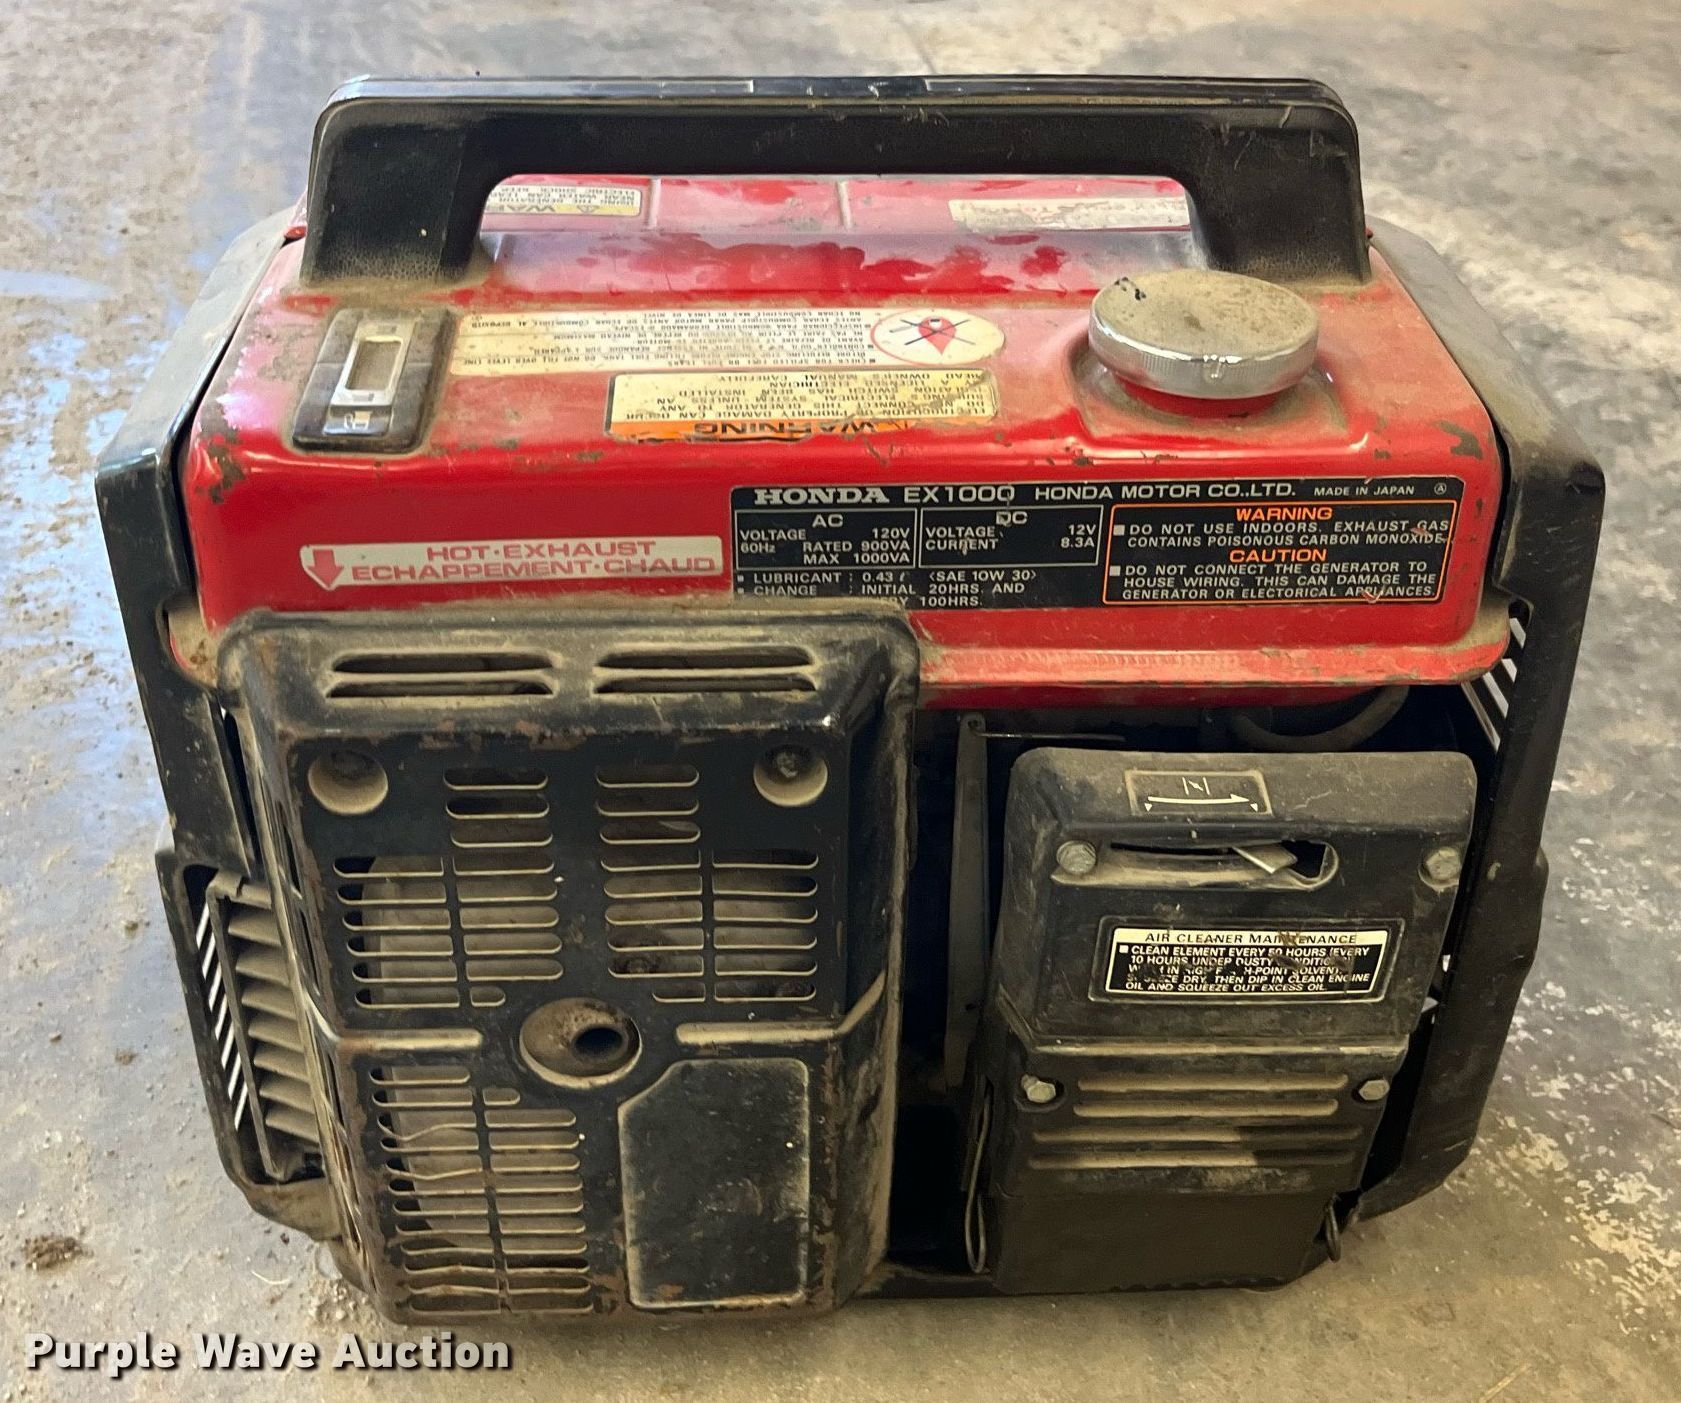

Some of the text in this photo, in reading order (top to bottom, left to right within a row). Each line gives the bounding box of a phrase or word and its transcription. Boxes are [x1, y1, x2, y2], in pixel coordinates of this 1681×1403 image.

[754, 488, 890, 505] HONDA
[904, 485, 1015, 502] EX1000
[1035, 486, 1113, 500] HONDA
[1122, 484, 1200, 500] MOTOR
[1314, 486, 1350, 496] MADE
[1355, 486, 1369, 496] IN
[1373, 485, 1415, 496] JAPAN
[812, 514, 843, 528] AC
[996, 511, 1028, 525] DC
[1236, 507, 1333, 522] WARNING
[740, 528, 910, 541] VOLTAGE 120V
[926, 525, 1096, 538] VOLTAGE 12V
[1130, 520, 1449, 535] DO NOT USE INDOORS. EXHAUST GAS
[740, 540, 910, 553] 60Hz RATED 900VA
[926, 537, 1095, 550] CURRENT 8.3A
[1127, 536, 1201, 547] CONTAINS
[1207, 534, 1293, 546] POISONOUS
[1299, 533, 1362, 546] CARBON
[803, 553, 910, 564] MAX 1000VA
[1229, 549, 1327, 563] CAUTION
[1125, 560, 1428, 576] DO NOT CONNECT THE GENERATOR TO
[754, 572, 841, 584] LUBRICANT
[862, 572, 893, 583] 0.43
[972, 570, 1005, 581] 10W
[1124, 572, 1437, 588] HOUSE WIRING. THIS CAN DAMAGE THE
[754, 585, 817, 596] CHANGE
[862, 585, 916, 595] INITIAL
[992, 582, 1025, 594] AND
[1122, 587, 1208, 600] GENERATOR
[1214, 586, 1235, 599] OR
[1241, 585, 1337, 599] ELECTORICAL
[1145, 933, 1170, 942] AIR
[1177, 934, 1243, 943] CLEANER
[1131, 945, 1170, 955] CLEAN
[1173, 946, 1226, 956] ELEMENT
[1228, 948, 1265, 956] EVERY
[1286, 948, 1326, 956] HOURS
[1131, 955, 1144, 963] 10
[1147, 956, 1189, 965] HOURS
[1214, 975, 1244, 983] THEN
[1288, 975, 1325, 983] CLEAN
[1126, 982, 1143, 990] OIL
[1148, 983, 1173, 991] AND
[1178, 984, 1229, 992] SQUEEZE
[1261, 984, 1304, 992] EXCESS
